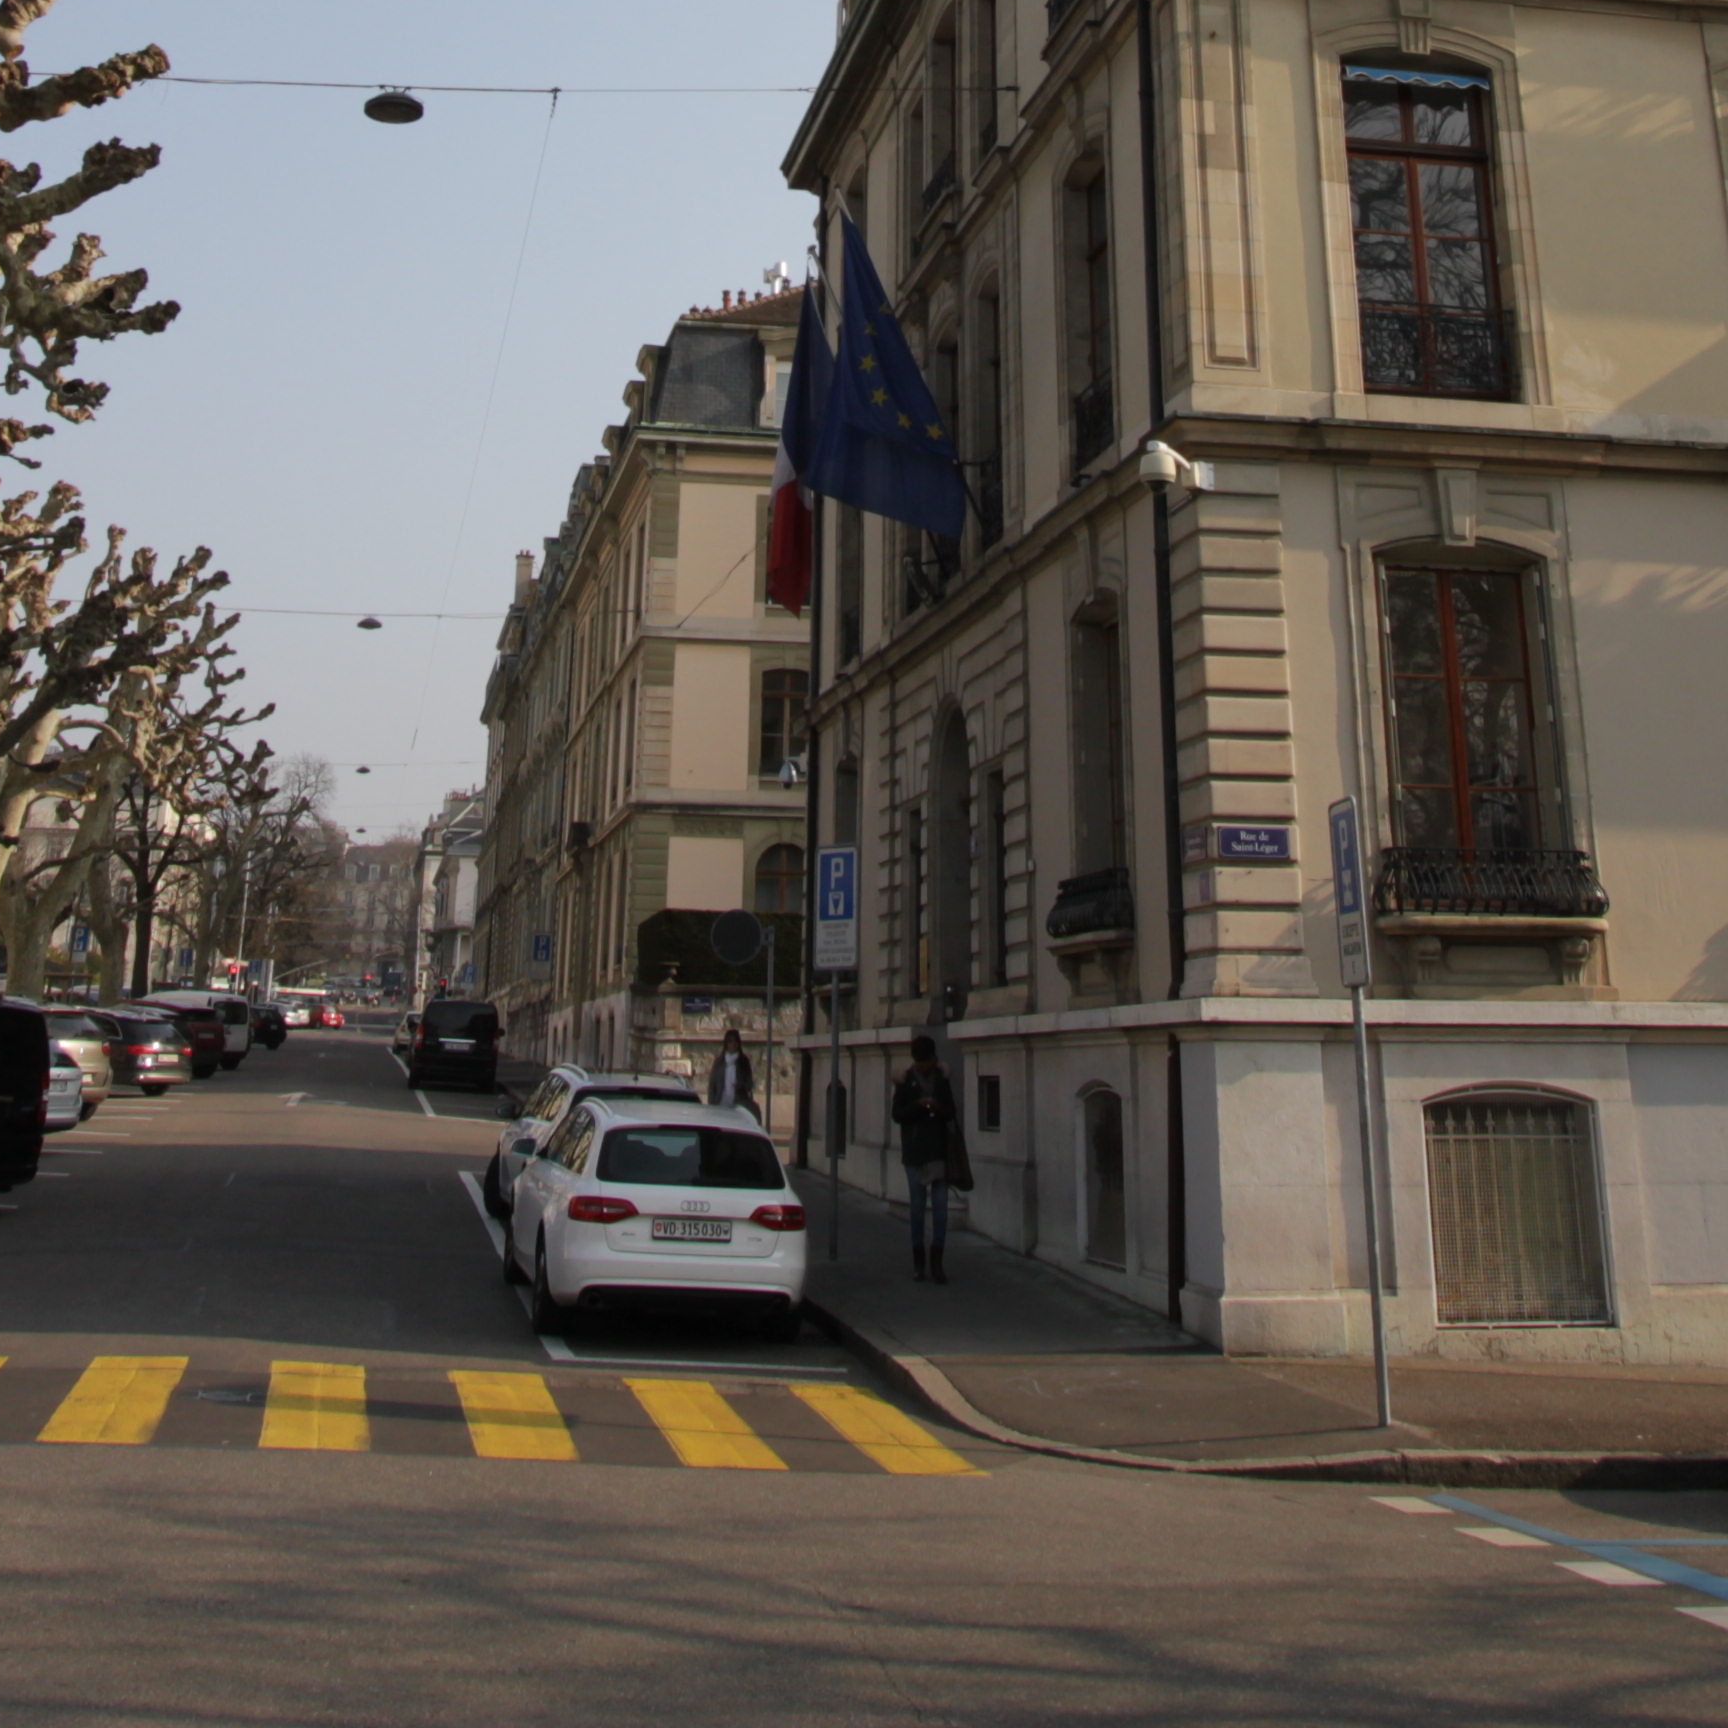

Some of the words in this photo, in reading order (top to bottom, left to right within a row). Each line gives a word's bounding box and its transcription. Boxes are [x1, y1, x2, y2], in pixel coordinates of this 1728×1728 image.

[1240, 830, 1257, 841] Rue
[1259, 831, 1270, 841] de
[1231, 841, 1278, 854] Saint-Léger
[831, 857, 844, 890] P
